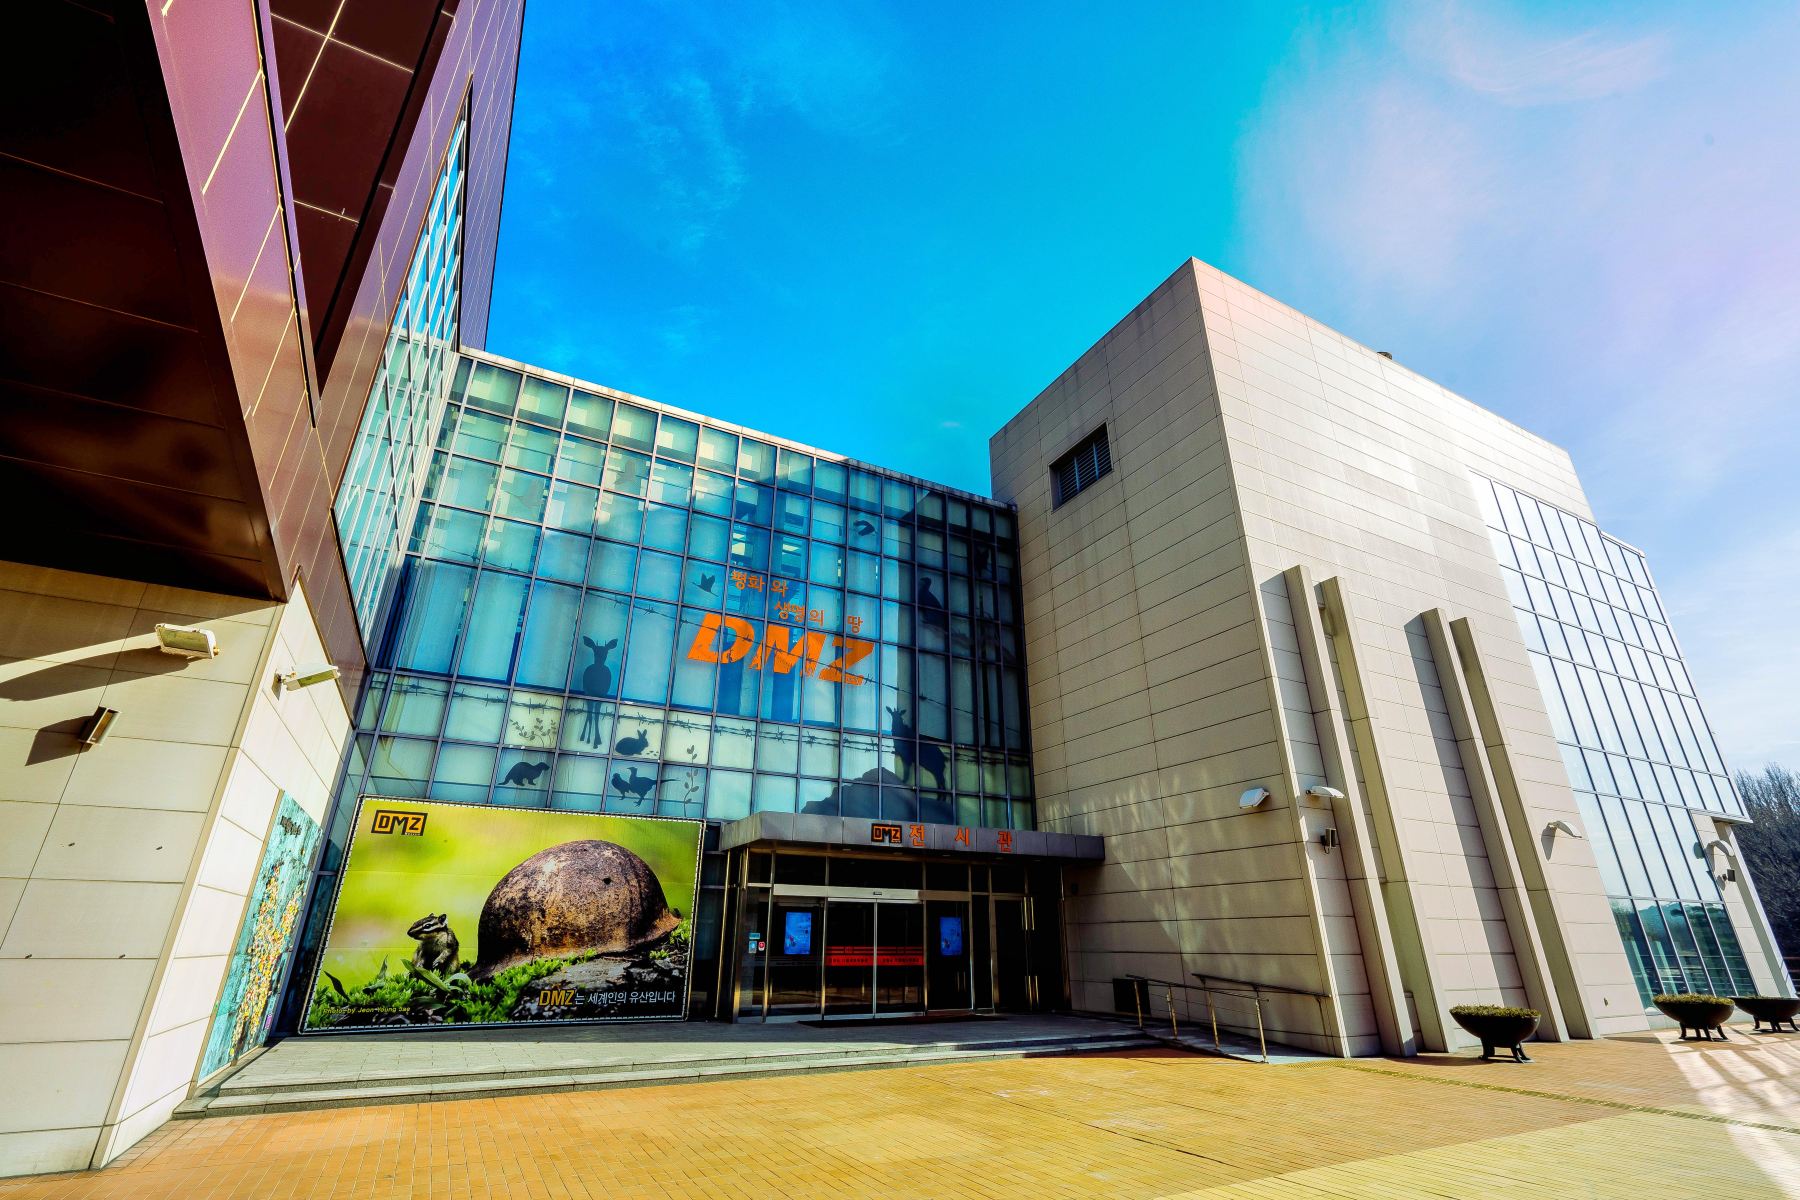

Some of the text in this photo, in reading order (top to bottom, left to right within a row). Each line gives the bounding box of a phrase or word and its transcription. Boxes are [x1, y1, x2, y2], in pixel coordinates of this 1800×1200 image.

[687, 612, 875, 686] DMZ
[374, 811, 425, 836] DMZ
[872, 825, 901, 843] DMZ
[587, 991, 627, 1006] 세계인의
[629, 990, 676, 1004] 유산입니다
